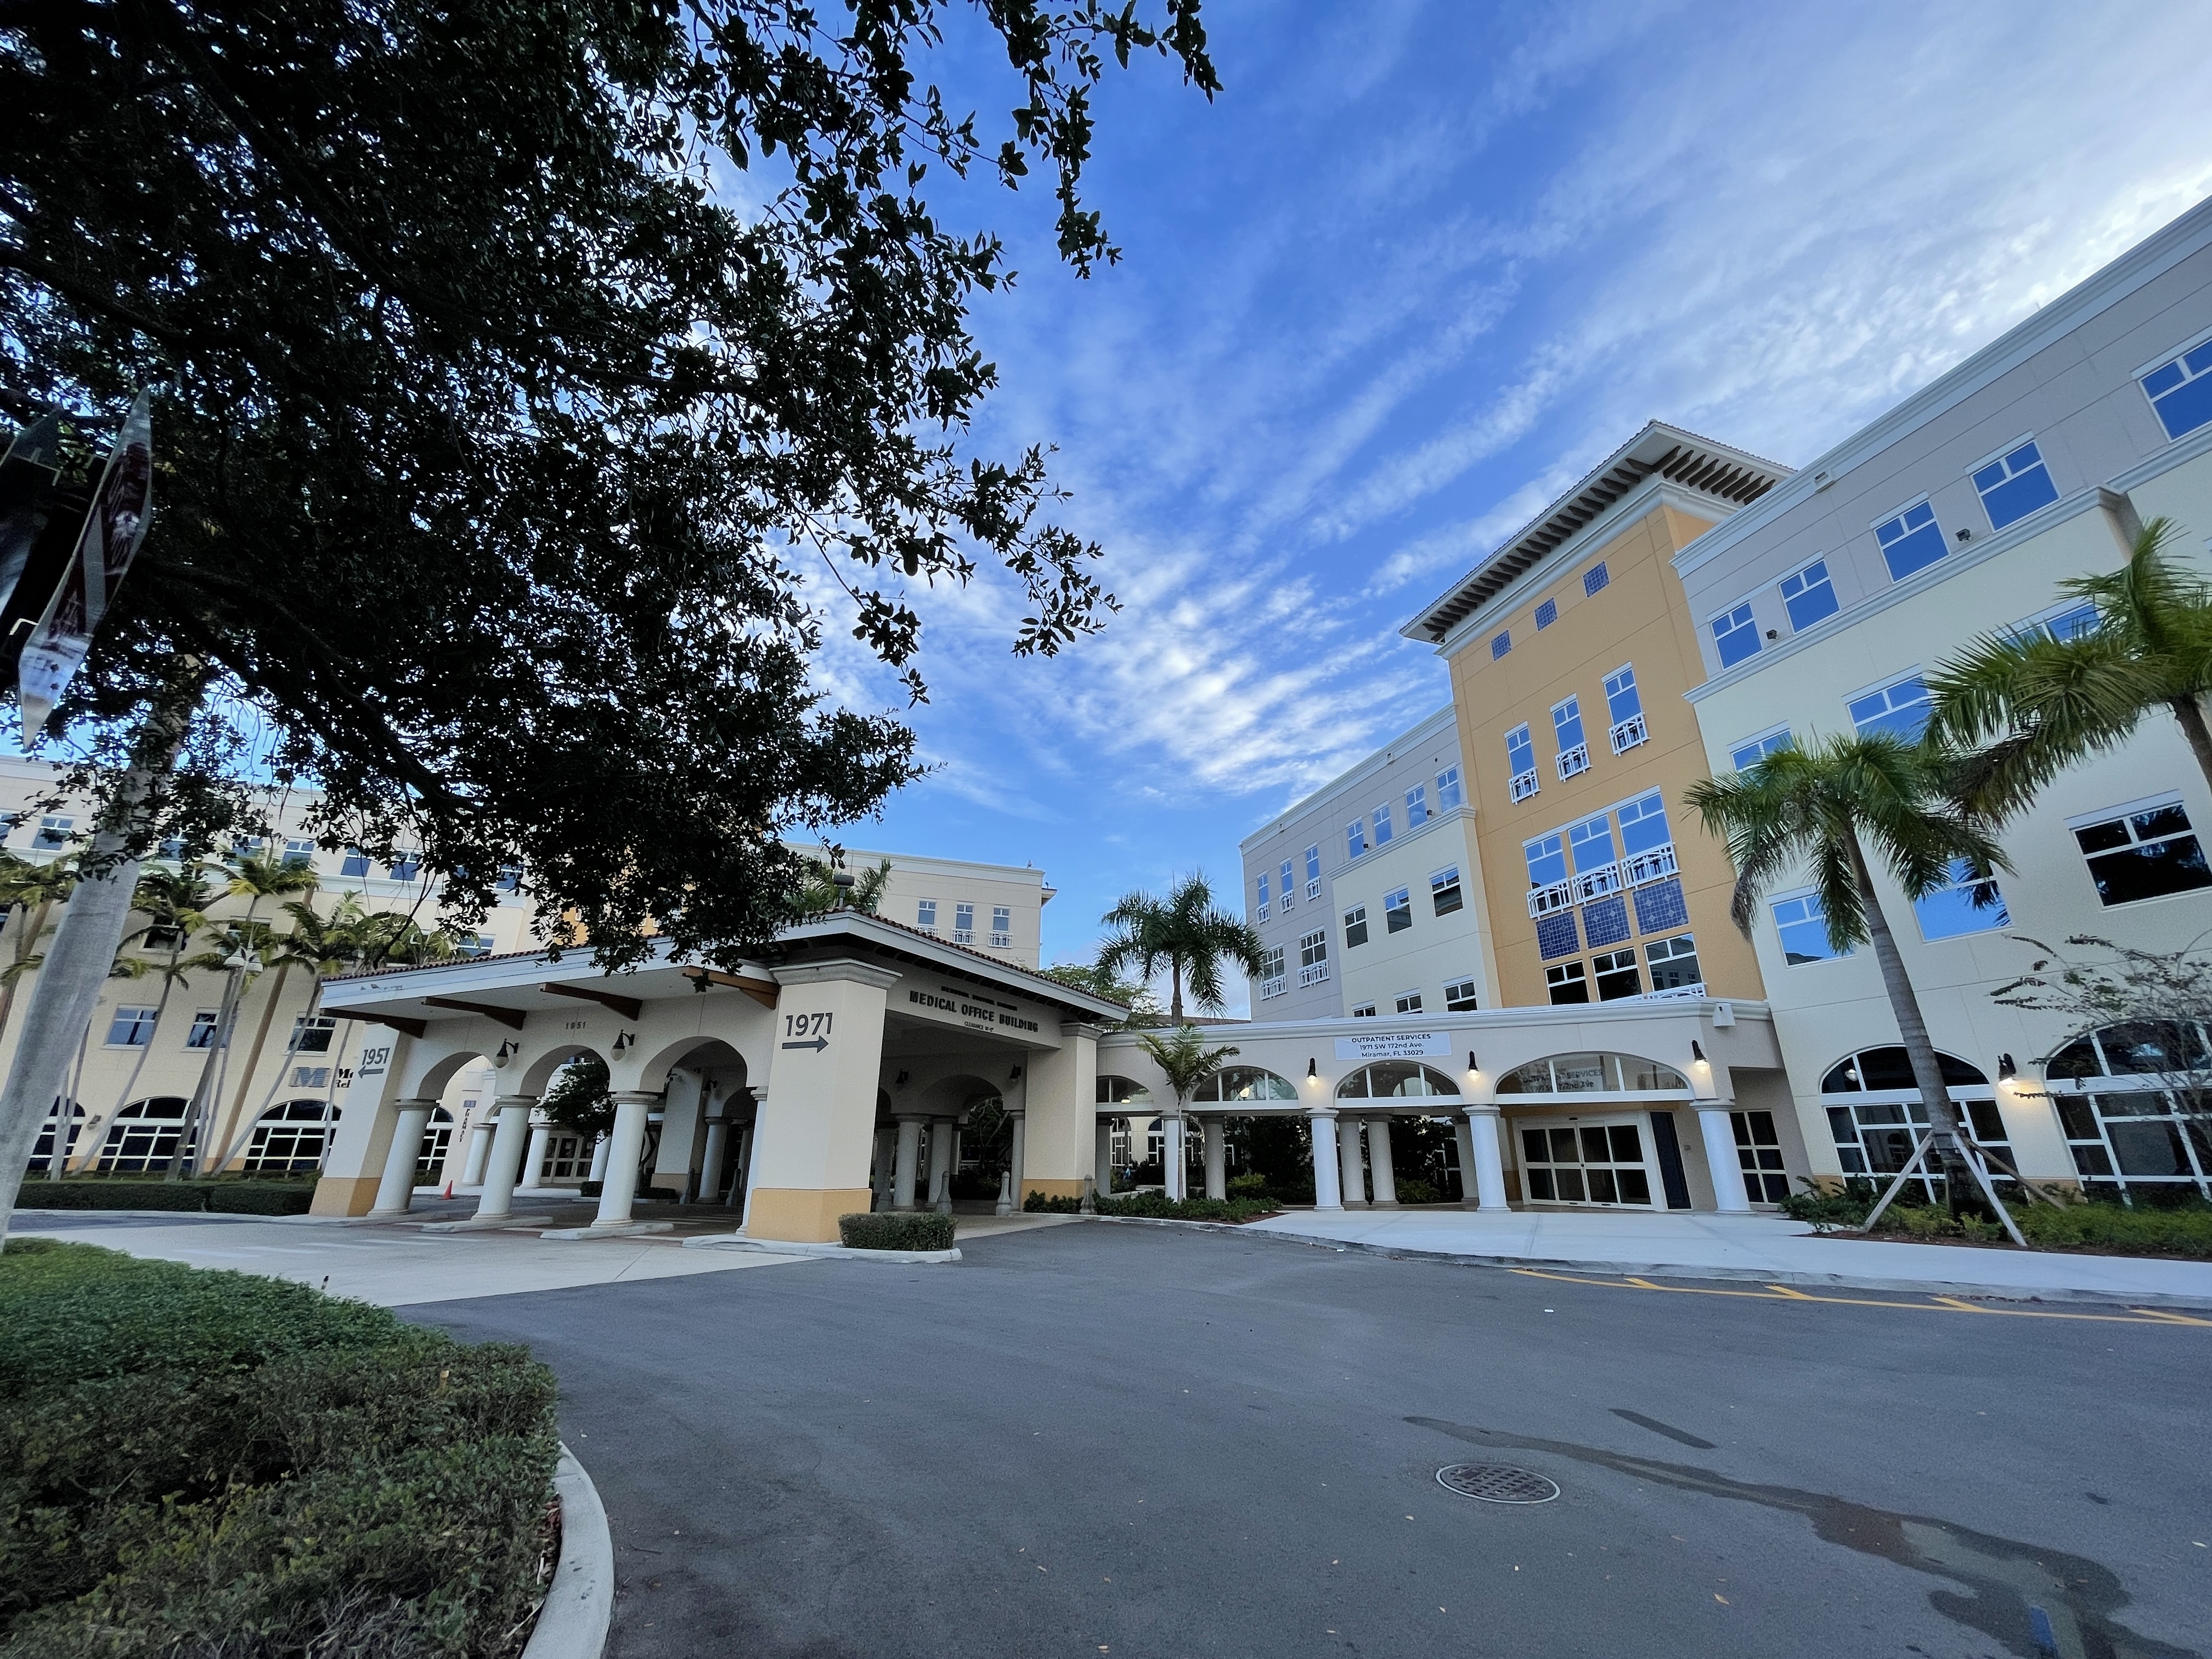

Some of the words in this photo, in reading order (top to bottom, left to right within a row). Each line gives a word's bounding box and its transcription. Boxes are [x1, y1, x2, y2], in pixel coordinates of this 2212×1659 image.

[909, 990, 957, 1012] MEDICAL
[961, 1004, 995, 1022] OFFICE
[999, 1014, 1038, 1032] BUILDING
[565, 1021, 586, 1030] 1951
[786, 1012, 833, 1036] 1971
